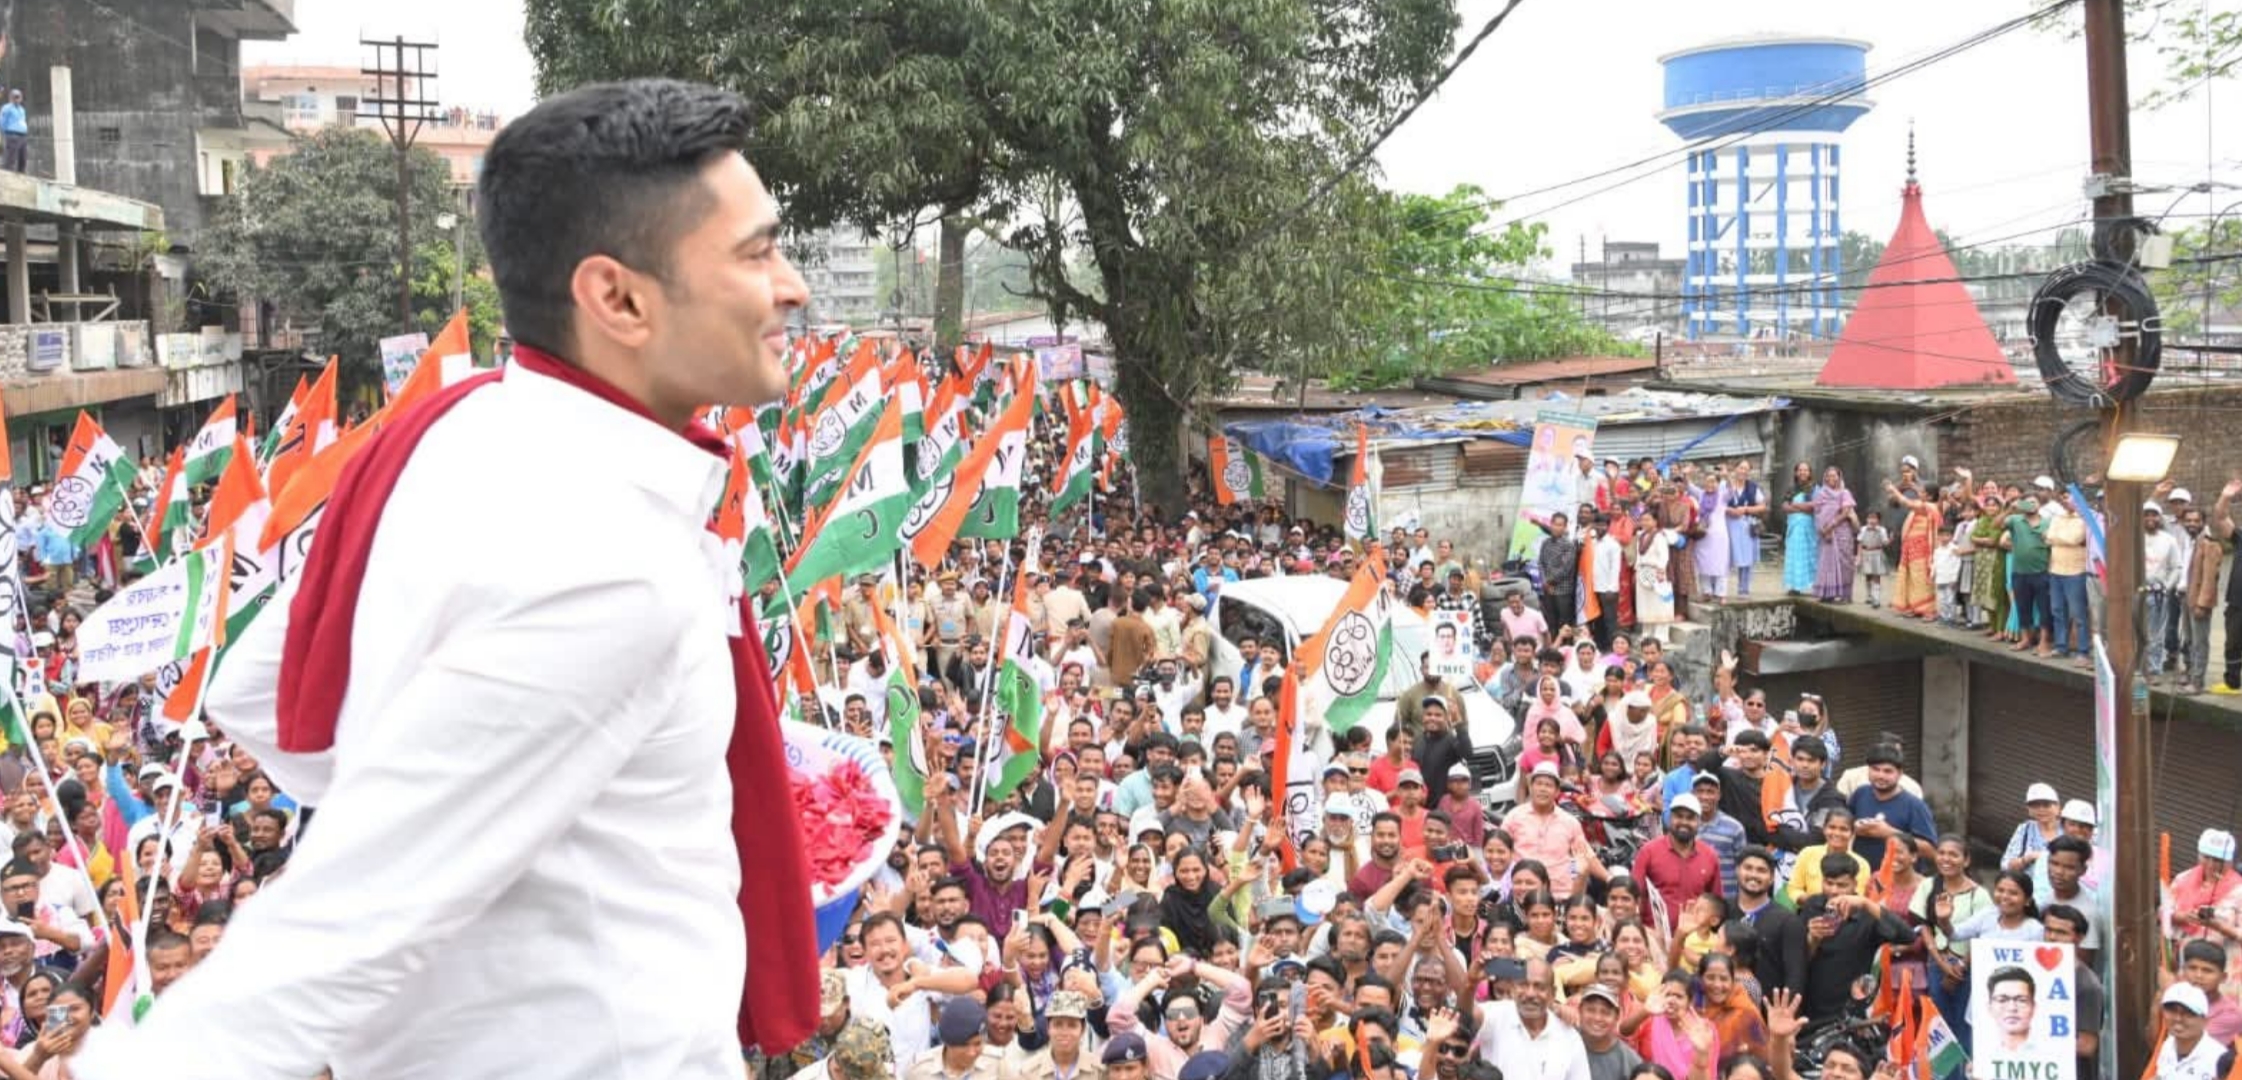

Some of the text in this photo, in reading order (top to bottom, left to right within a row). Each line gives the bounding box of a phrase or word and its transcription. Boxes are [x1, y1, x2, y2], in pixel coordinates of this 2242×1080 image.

[849, 391, 868, 413] M
[198, 432, 212, 450] M
[773, 453, 792, 475] M
[849, 460, 875, 499] M
[1993, 947, 2024, 962] WE
[2047, 977, 2070, 1000] A
[2049, 1015, 2071, 1037] B
[1992, 1060, 2059, 1080] TMYC
